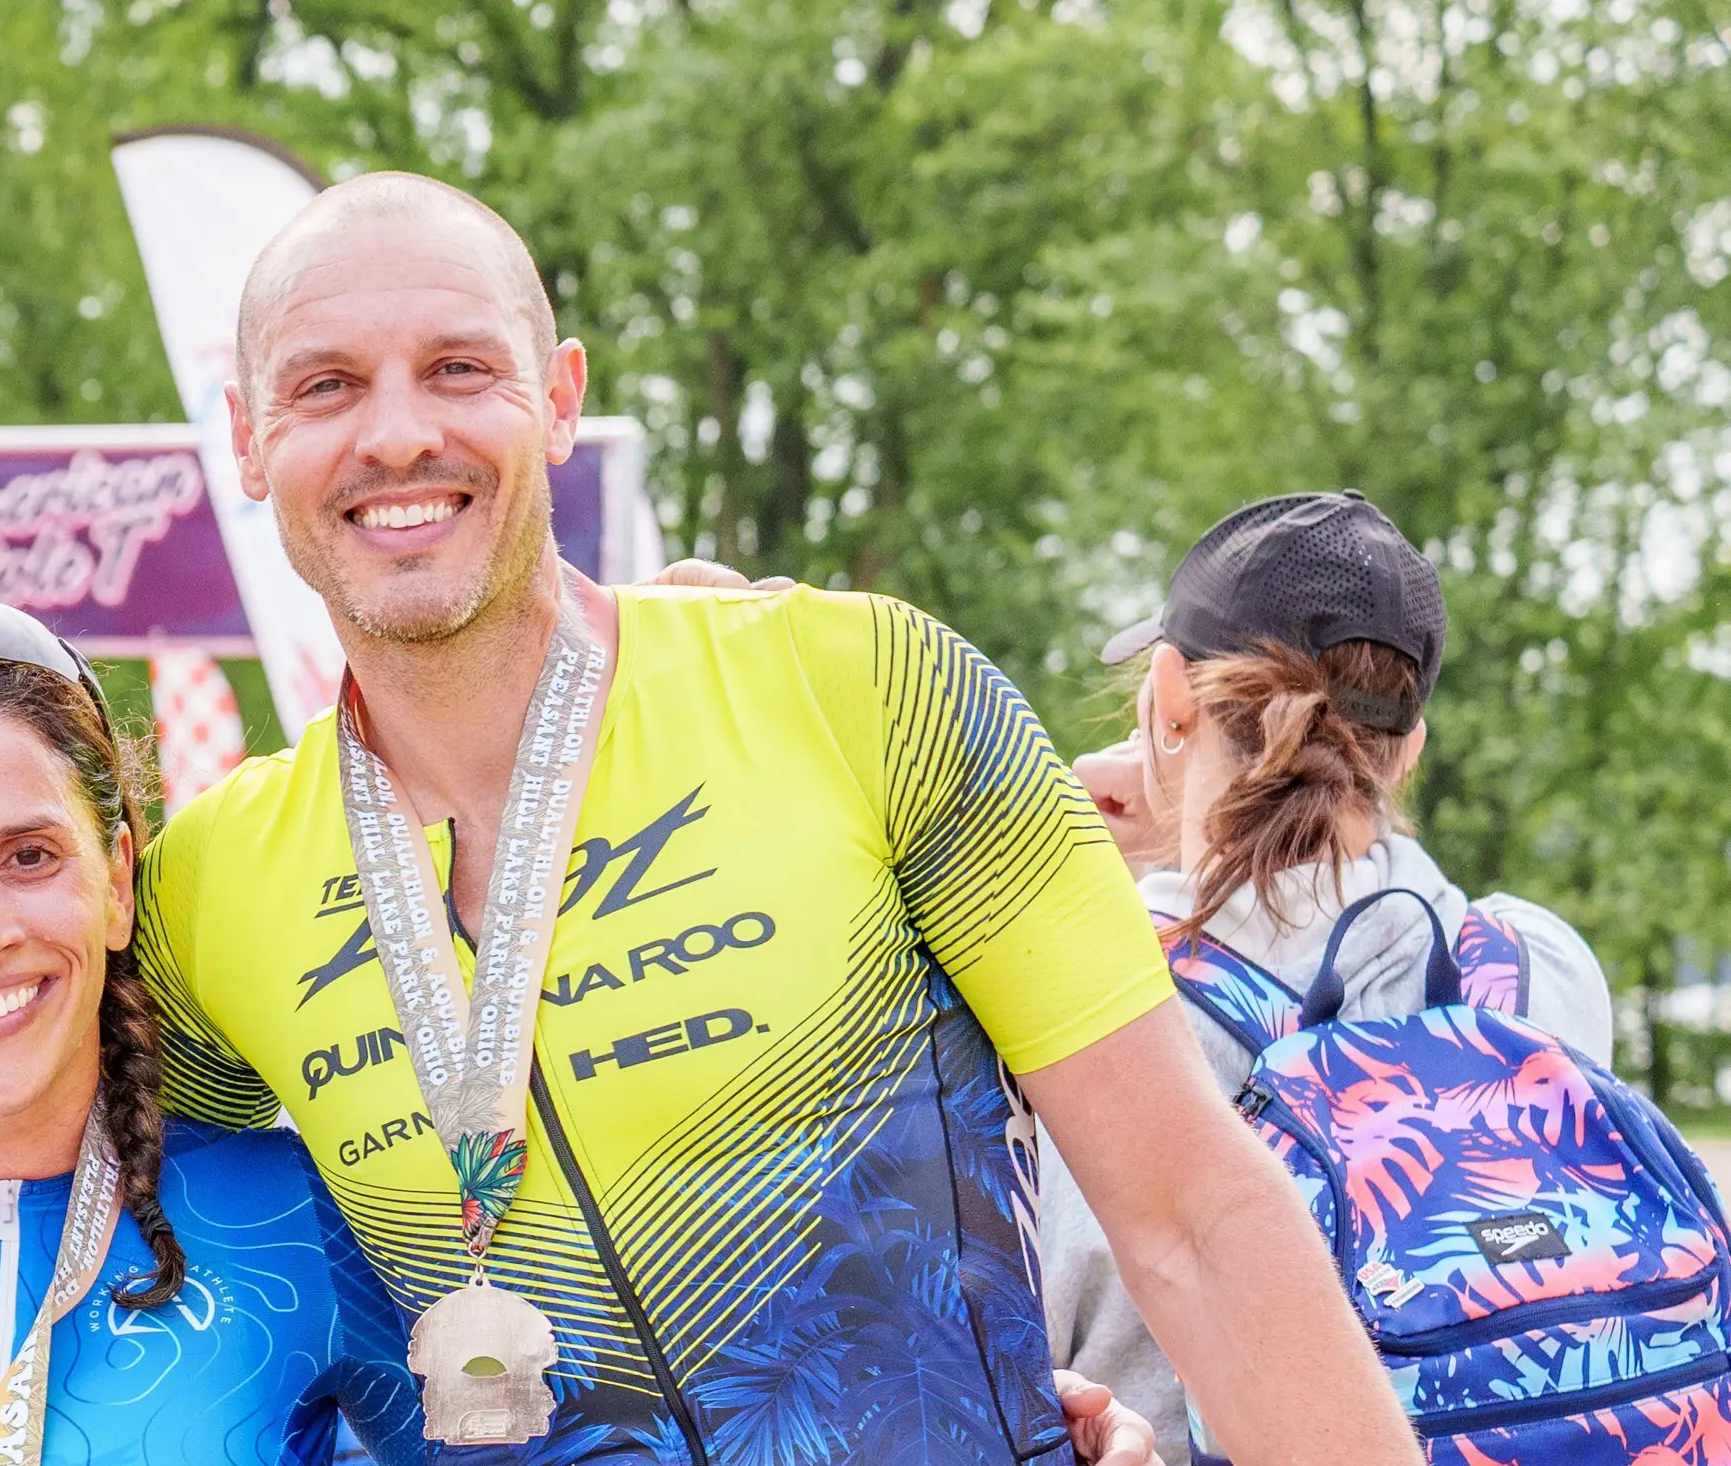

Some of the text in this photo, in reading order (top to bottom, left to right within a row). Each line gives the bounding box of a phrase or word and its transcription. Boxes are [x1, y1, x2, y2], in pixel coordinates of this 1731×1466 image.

[476, 647, 579, 1069] PLEASANT HILL LAKE PARK OHIO
[372, 871, 403, 936] LAKE
[389, 940, 426, 1011] PARK
[416, 1025, 449, 1087] OHIO
[70, 1152, 100, 1260] PLEASANT
[1480, 1220, 1549, 1245] speedo
